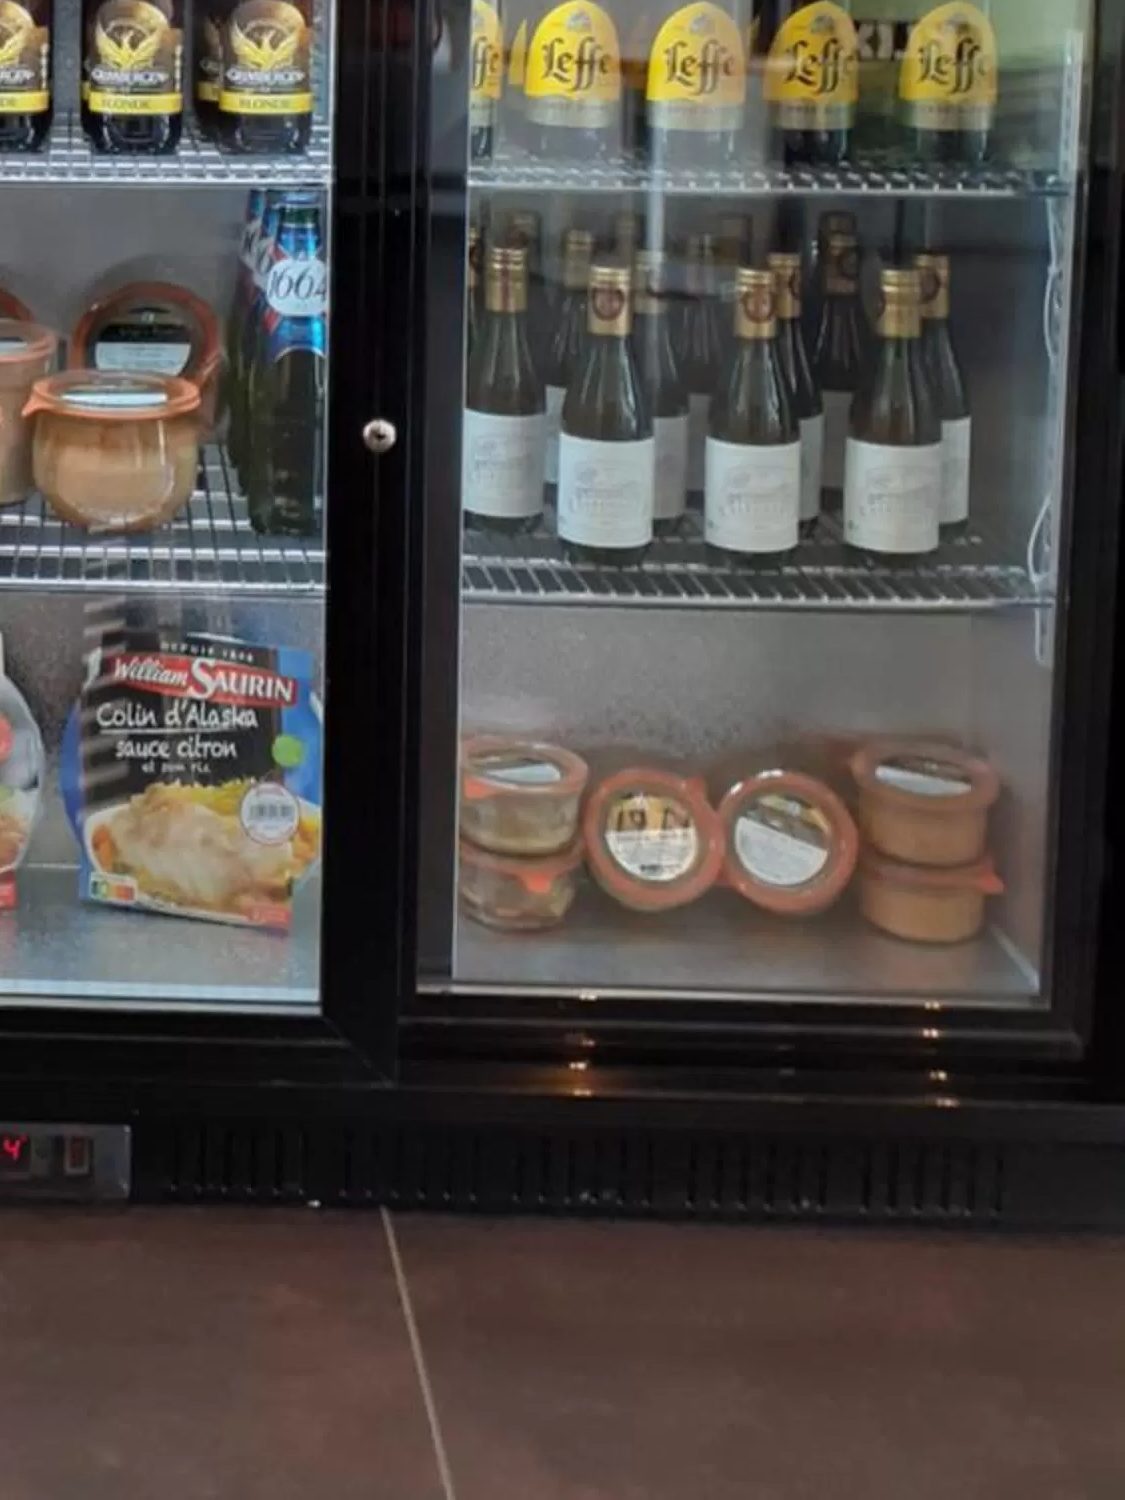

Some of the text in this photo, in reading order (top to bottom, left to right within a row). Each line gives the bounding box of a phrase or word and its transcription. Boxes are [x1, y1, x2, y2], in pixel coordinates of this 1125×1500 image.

[541, 36, 613, 92] Leffe
[664, 40, 736, 97] Leffe
[783, 37, 854, 94] Leffe
[916, 37, 988, 94] Leffe
[112, 656, 296, 702] William SAURIN
[95, 694, 260, 729] Colin d'Alaska
[115, 732, 238, 761] sauce citron
